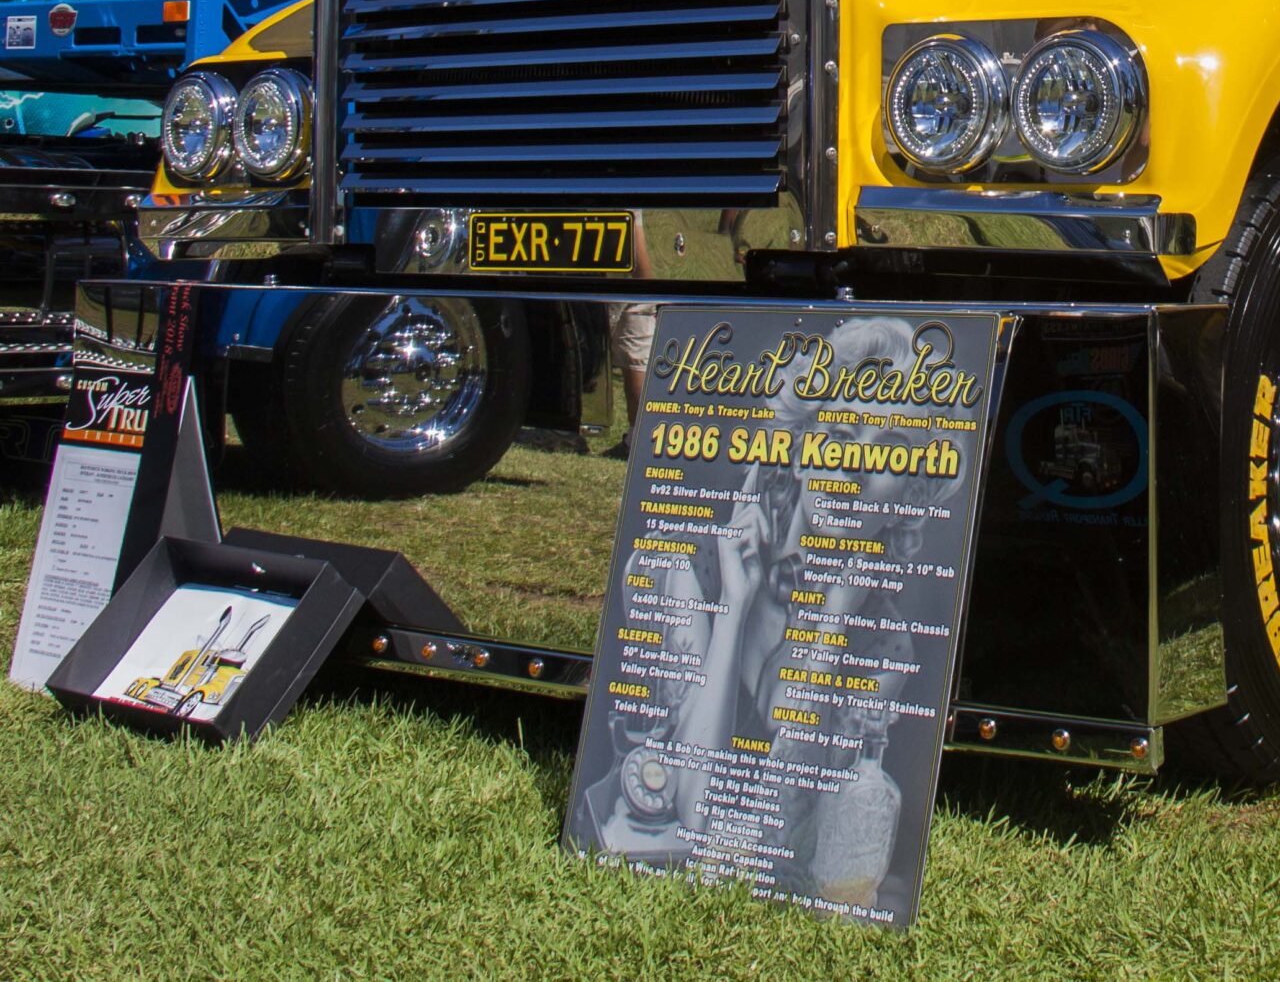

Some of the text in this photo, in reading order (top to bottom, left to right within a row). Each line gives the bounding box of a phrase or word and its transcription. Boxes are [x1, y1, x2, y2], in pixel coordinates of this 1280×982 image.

[655, 320, 982, 406] Heart Breaker
[77, 379, 109, 392] CUSTOM
[65, 376, 151, 430] Super
[646, 401, 775, 419] OWNER: Tony & Tracey Lake
[107, 404, 149, 434] TRU
[818, 411, 977, 431] DRIVER: Tony (Thomo) Thomas
[652, 421, 960, 477] 1986 SAR Kenworth
[645, 467, 684, 480] ENGINE:
[651, 484, 761, 503] 8v92 Silver Detroit Diesel
[808, 479, 861, 494] INTERIOR:
[641, 501, 714, 518] TRANSMISSION:
[815, 498, 951, 518] Custom Black & Yellow Trim
[646, 519, 743, 538] 15 Speed Road Ranger
[812, 514, 862, 529] By Raeline
[633, 538, 697, 554] SUSPENSION:
[801, 535, 885, 554] SOUND SYSTEM:
[639, 555, 691, 570] Airglide 100
[806, 553, 955, 578] Pioneer, 6 Speakers, 2 Sub
[627, 575, 654, 589] FUEL:
[804, 570, 904, 593] Woofers, 1000w Amp
[632, 592, 730, 614] 4x400 Litres Stainless
[792, 590, 826, 605] PAINT:
[630, 609, 692, 627] Steel Wrapped
[798, 609, 950, 636] Primrose Yellow, Black Chassis
[618, 628, 663, 644] SLEEPER:
[785, 628, 848, 647] FRONT BAR:
[640, 648, 702, 666] Low-Rise With
[811, 649, 921, 674] Valley Chrome Bumper
[620, 662, 707, 686] Valley Chrome Wing
[780, 667, 879, 692] REAR BAR & DECK:
[609, 681, 651, 698] GAUGES:
[614, 699, 669, 718] Telek Digital
[786, 687, 830, 703] Stainless
[833, 691, 844, 707] by
[889, 700, 936, 718] Stainless
[773, 707, 820, 725] MURALS:
[732, 737, 771, 754] THANKS
[780, 726, 864, 750] Painted by Kipart
[645, 738, 859, 781] Mum & Bob for making this whole project possible
[659, 754, 840, 794] Thomo for all his work & time on this build
[710, 776, 779, 798] Big Rig Bullbars
[740, 795, 781, 812] Stainless
[696, 802, 785, 829] Big Rig Chrome Shop
[711, 820, 763, 838] HB Kustoms
[677, 826, 795, 859] Highway Truck Accessories
[692, 845, 774, 870] Autobarn Capalaba
[814, 898, 850, 915] through
[853, 905, 868, 918] the
[870, 908, 894, 923] build
